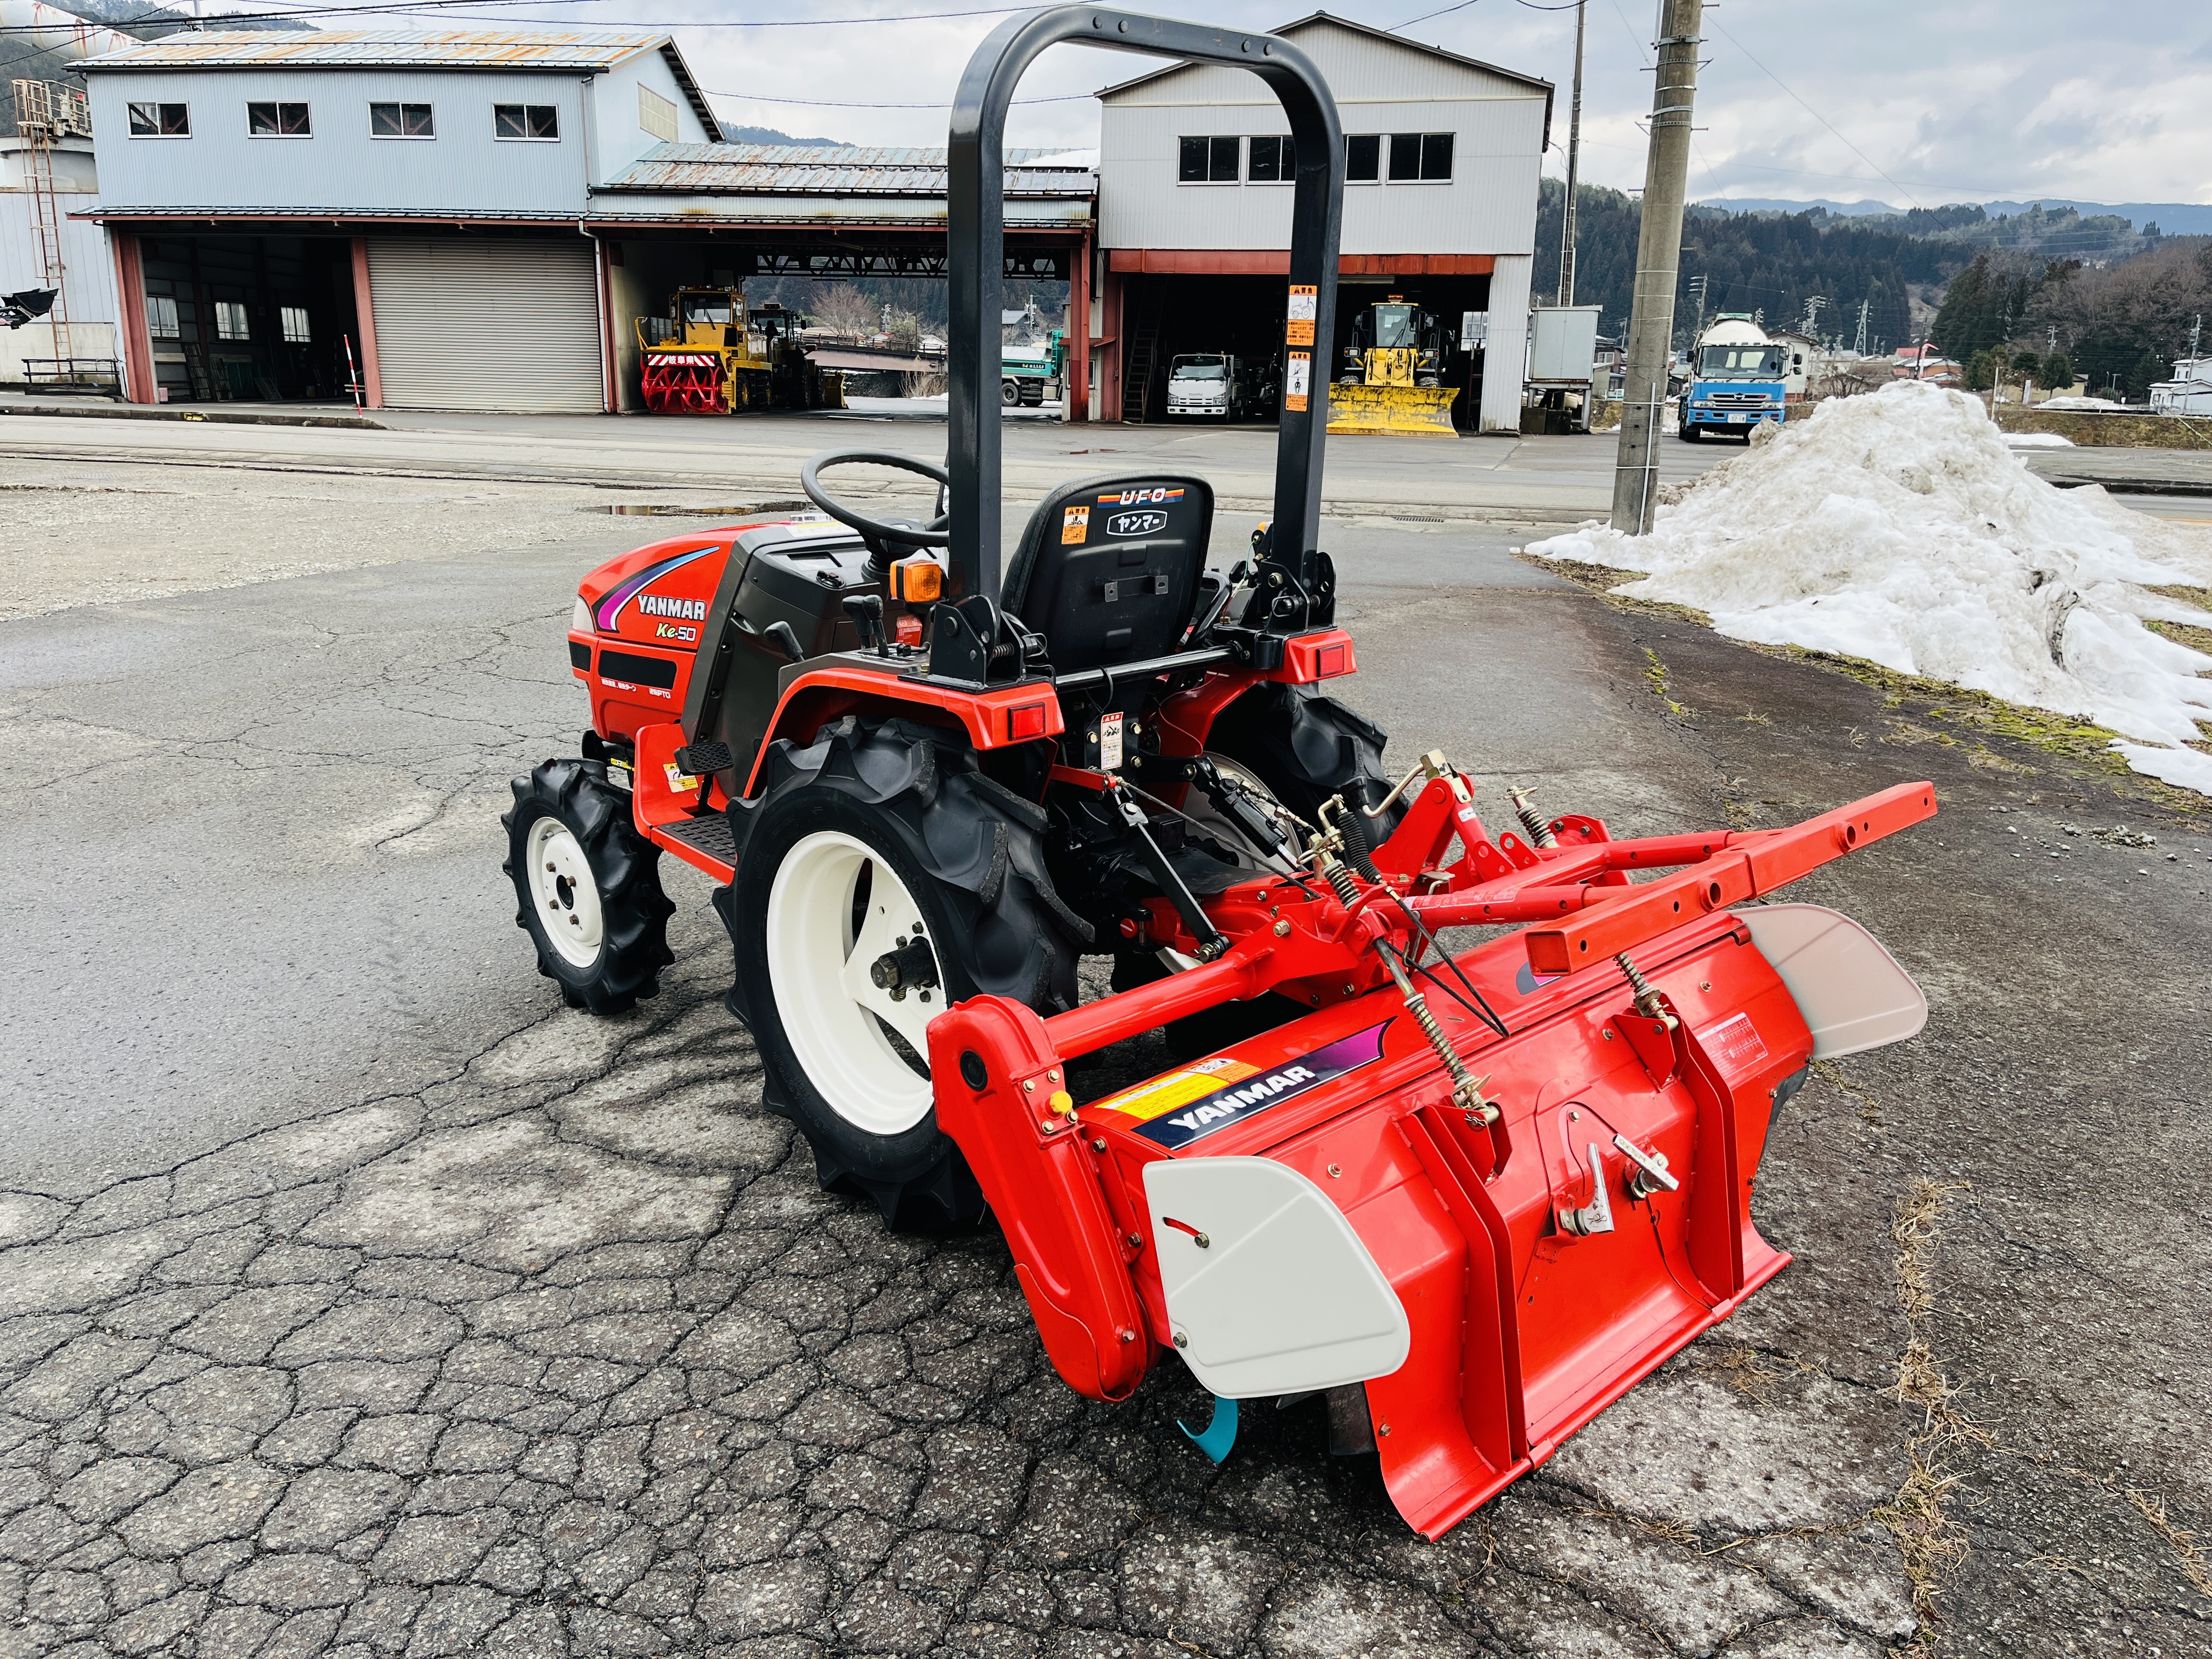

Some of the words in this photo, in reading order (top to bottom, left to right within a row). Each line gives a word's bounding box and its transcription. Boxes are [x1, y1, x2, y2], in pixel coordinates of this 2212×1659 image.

[668, 355, 695, 365] 岐阜県
[1119, 487, 1166, 505] UFO
[1118, 515, 1160, 533] ヤンマー
[637, 594, 707, 621] YANMAR
[1167, 1066, 1316, 1130] YANMAR
